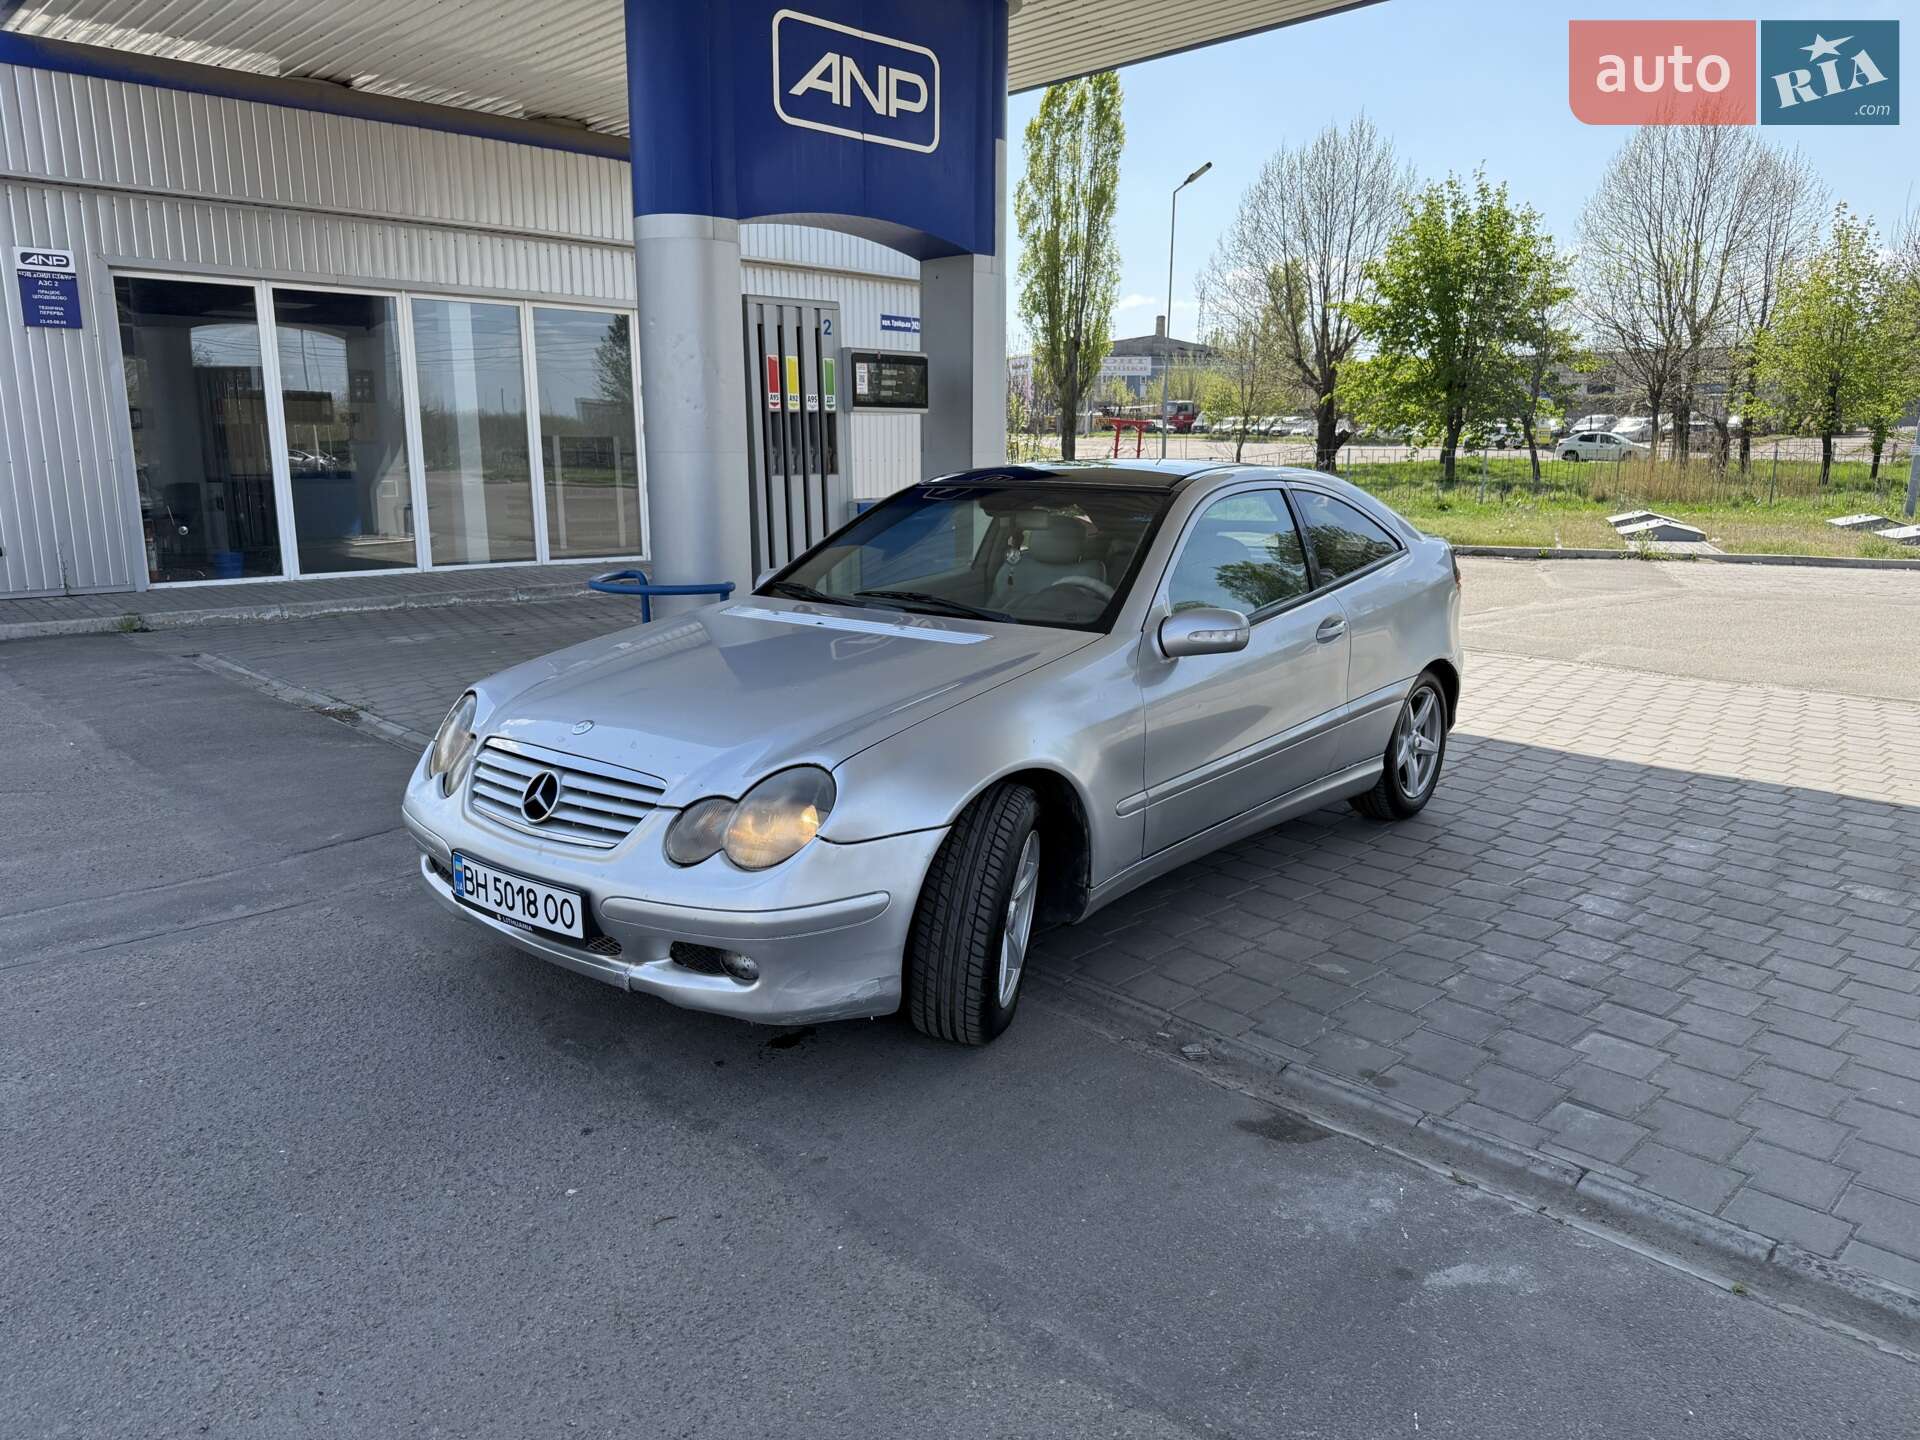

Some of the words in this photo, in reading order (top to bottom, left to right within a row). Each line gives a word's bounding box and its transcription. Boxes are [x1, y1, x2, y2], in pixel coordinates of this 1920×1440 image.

[788, 51, 929, 118] ANP
[24, 254, 67, 265] ANP
[823, 319, 832, 335] 2
[463, 865, 489, 902] BH
[493, 876, 538, 918] 5018
[502, 916, 533, 931] LITHUANIA
